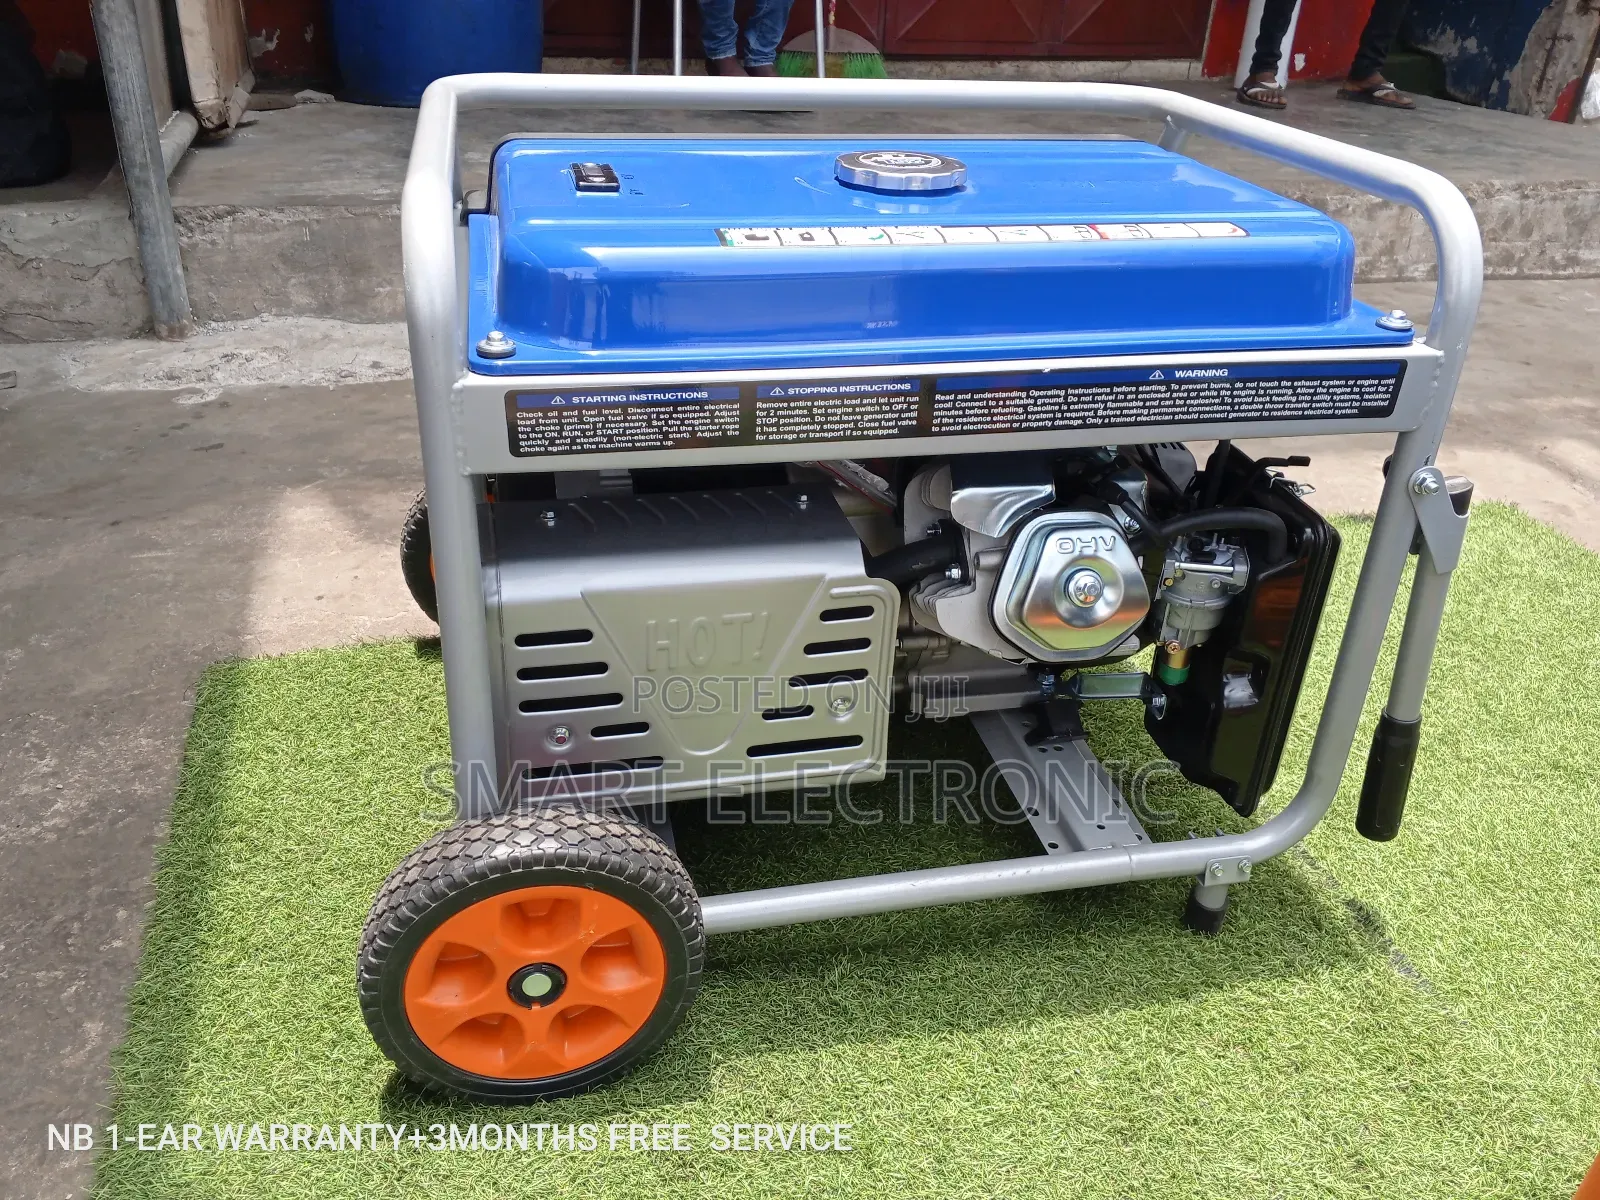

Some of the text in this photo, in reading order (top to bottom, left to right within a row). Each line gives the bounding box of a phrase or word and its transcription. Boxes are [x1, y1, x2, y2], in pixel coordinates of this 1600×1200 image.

[1175, 368, 1229, 378] WARNING
[788, 383, 911, 394] STOPPING INSTRUCTIONS
[973, 390, 1027, 400] understanding
[1029, 389, 1066, 398] Operating
[1181, 383, 1208, 392] prevent
[1322, 379, 1346, 387] system
[572, 392, 709, 403] STARTING INSTRUCTIONS
[583, 415, 605, 423] Open
[673, 411, 712, 420] equipped.
[714, 410, 740, 418] Adjust
[827, 406, 853, 415] engine
[564, 423, 593, 431] (prime)
[684, 418, 711, 426] engine
[780, 416, 813, 425] position.
[863, 412, 899, 421] generator
[963, 421, 1011, 430] electrocution
[1022, 419, 1053, 428] property
[1086, 417, 1103, 425] Only
[1228, 411, 1261, 419] generator
[626, 427, 661, 435] position.
[769, 432, 798, 441] storage
[809, 430, 844, 439] transport
[863, 427, 900, 436] equipped.
[780, 423, 821, 433] completely
[823, 422, 856, 431] stopped.
[519, 438, 550, 447] quickly
[576, 436, 608, 444] steadily
[613, 433, 663, 442] (non-electric
[668, 432, 692, 440] start).
[696, 430, 722, 439] Adjust
[547, 444, 570, 452] again
[1056, 535, 1116, 554] OHV
[645, 611, 770, 671] HOT!
